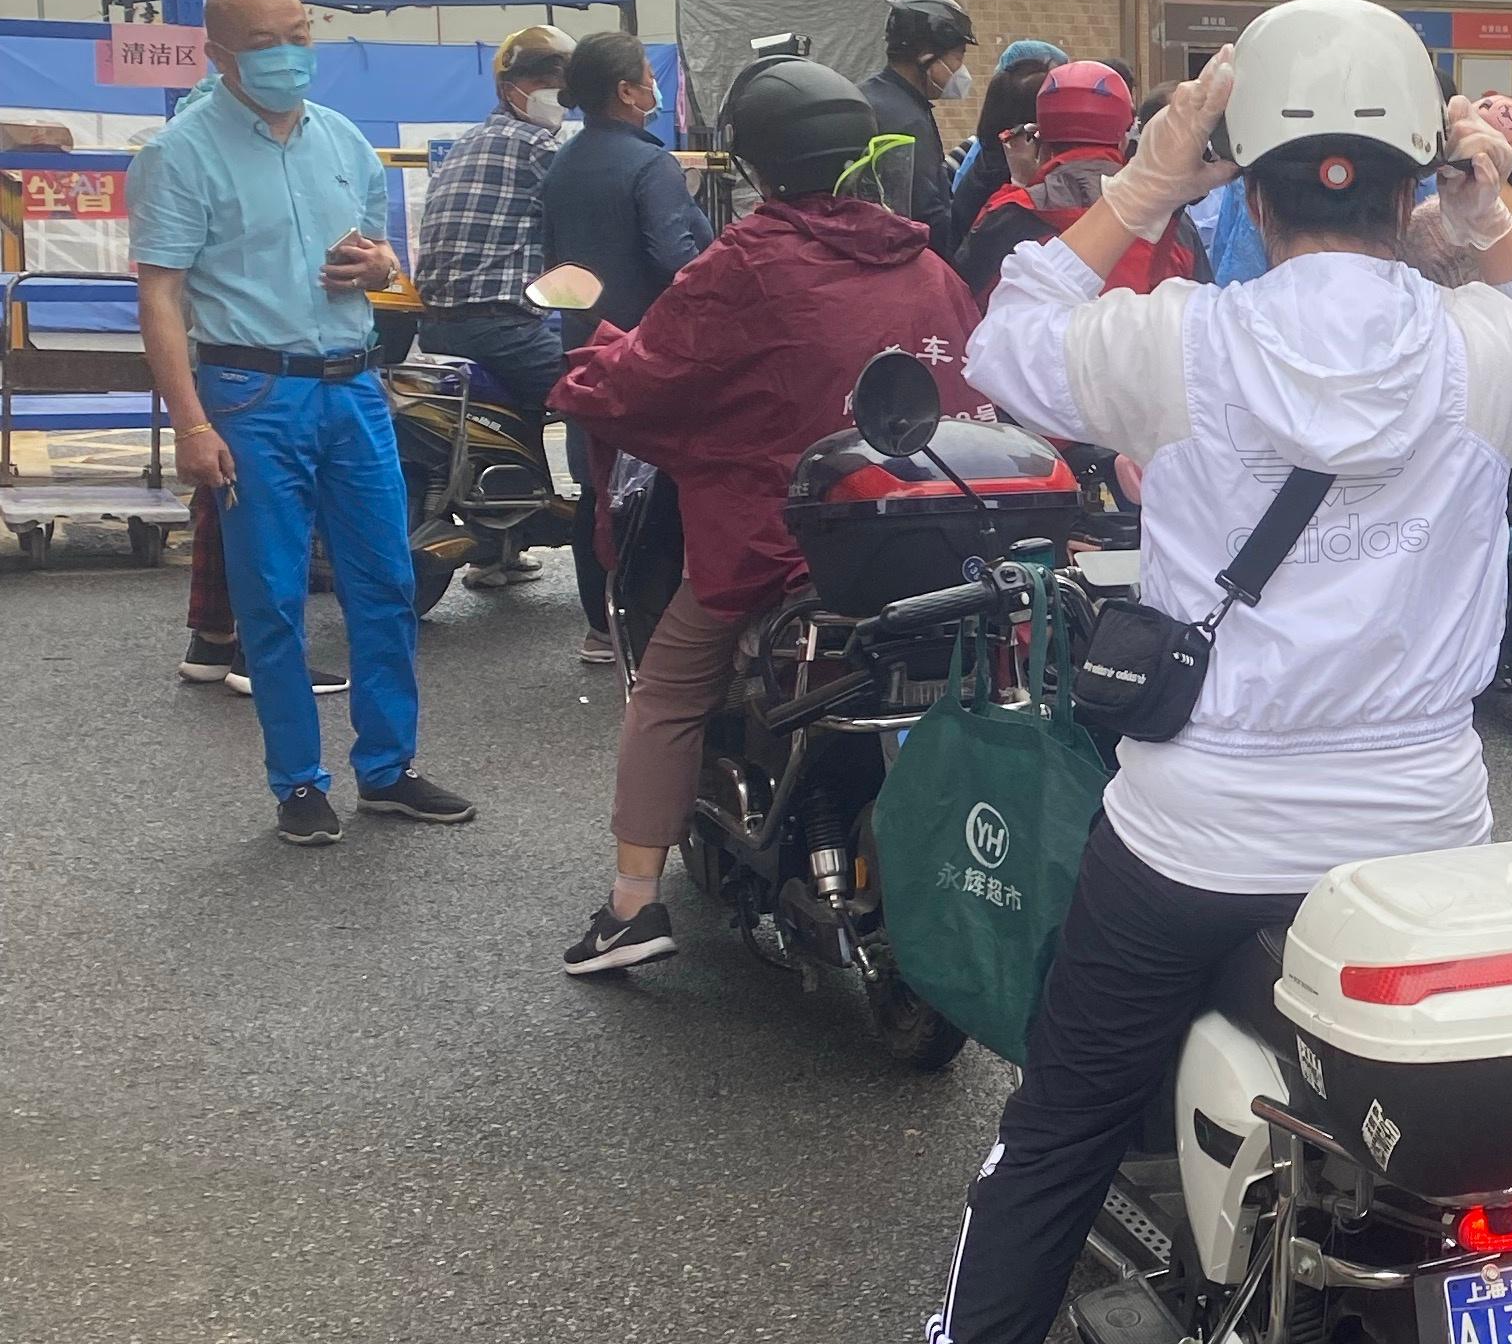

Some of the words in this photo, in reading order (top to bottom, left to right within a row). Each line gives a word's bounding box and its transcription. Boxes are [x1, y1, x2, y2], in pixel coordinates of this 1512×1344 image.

[121, 41, 197, 67] 清洁区
[1226, 513, 1430, 564] idas
[976, 816, 1005, 857] YH
[935, 861, 1023, 912] 永辉超市
[1466, 1278, 1508, 1304] 上海
